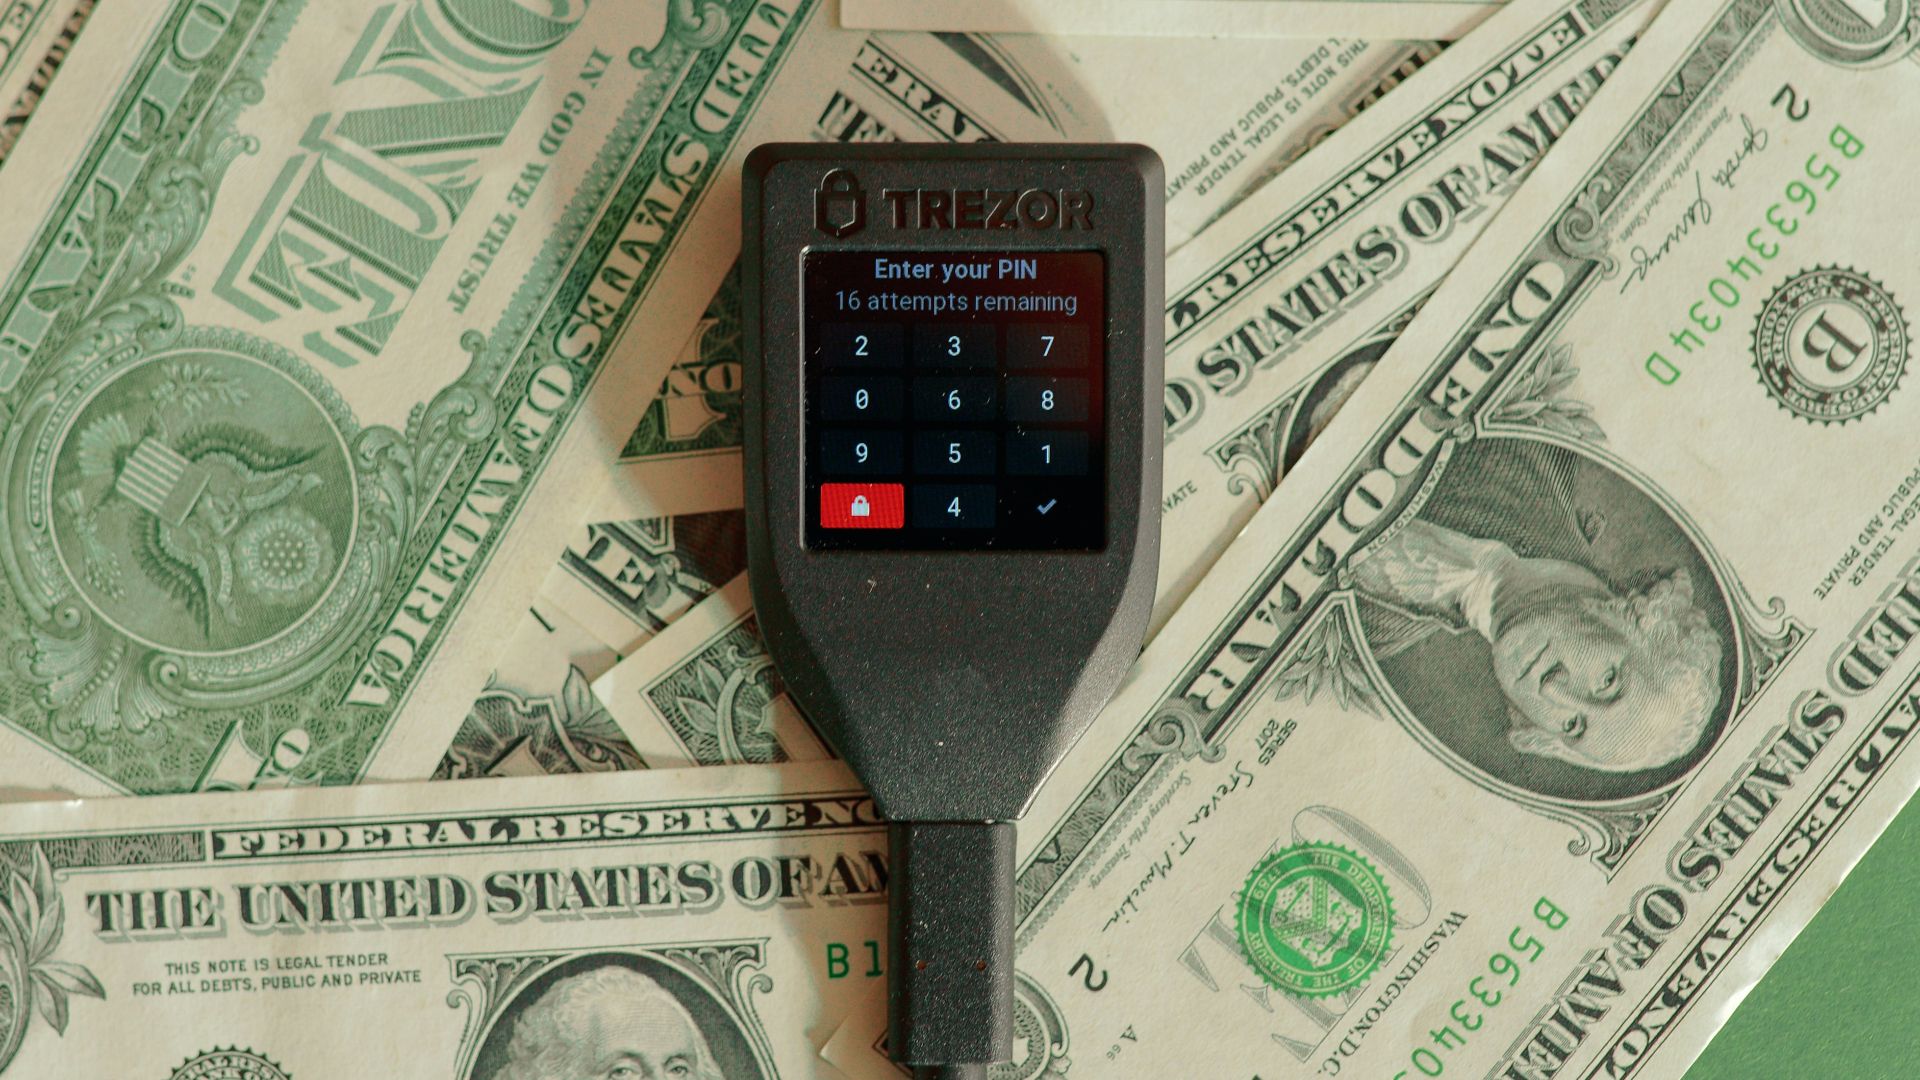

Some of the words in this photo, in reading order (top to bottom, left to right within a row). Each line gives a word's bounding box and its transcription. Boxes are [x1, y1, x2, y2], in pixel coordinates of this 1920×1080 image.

[576, 46, 613, 89] IN
[1335, 35, 1369, 67] THIS
[1300, 64, 1337, 99] NOTE
[1769, 81, 1815, 126] 2
[535, 88, 588, 159] GOD
[1235, 86, 1285, 132] PUBLIC
[1283, 96, 1302, 115] IS
[1207, 127, 1239, 158] AND
[1243, 111, 1285, 151] LEGAL
[504, 156, 548, 210] WE
[1166, 153, 1210, 203] PRIVAT
[1192, 147, 1246, 197] TENDER
[1201, 119, 1439, 306] RESERVE
[1430, 14, 1582, 136] NOTE
[882, 188, 1094, 230] TREZOR
[442, 208, 518, 315] TRUST
[547, 128, 712, 374] STATES
[875, 259, 933, 280] Enter
[941, 263, 992, 284] your
[998, 259, 1038, 280] PIN
[1193, 221, 1405, 395] STATES
[1393, 164, 1483, 246] OF
[836, 291, 861, 311] 16
[868, 293, 968, 315] attempts
[974, 292, 1077, 316] remaining
[855, 336, 868, 356] 2
[948, 336, 961, 356] 3
[1041, 336, 1055, 356] 7
[1426, 252, 1571, 419] ONE
[1802, 309, 1868, 373] B
[498, 356, 580, 459] OF
[856, 389, 869, 410] 0
[948, 390, 961, 410] 6
[1041, 390, 1054, 410] 8
[856, 443, 868, 463] 9
[948, 443, 961, 463] 5
[1041, 444, 1051, 464] 1
[947, 497, 961, 517] 4
[1855, 514, 1885, 547] AND
[342, 437, 533, 721] AMERICA
[1179, 406, 1447, 720] DOLLAR
[1812, 545, 1860, 600] PRIVATE
[1847, 533, 1895, 587] TENDER
[1253, 718, 1280, 750] 2017
[1257, 718, 1298, 766] SERIES
[1664, 687, 1848, 893] STATES
[216, 818, 511, 858] FEDERAL
[519, 804, 805, 841] RESERVE
[86, 887, 220, 939] THE
[233, 875, 474, 933] UNITED
[484, 861, 721, 921] STATES
[731, 855, 817, 906] OF
[1663, 765, 1861, 1003] RESERVE
[1607, 879, 1691, 970] OF
[133, 982, 162, 997] FOR
[168, 981, 196, 995] ALL
[201, 978, 257, 994] DEBTS,
[262, 975, 316, 990] PUBLIC
[321, 973, 353, 988] AND
[359, 970, 422, 985] PRIVATE
[165, 961, 200, 976] THIS
[208, 959, 247, 974] NOTE
[254, 958, 269, 972] IS
[276, 956, 322, 970] LEGAL
[325, 953, 388, 968] TENDER
[1066, 952, 1112, 997] 2
[1119, 1024, 1138, 1042] A
